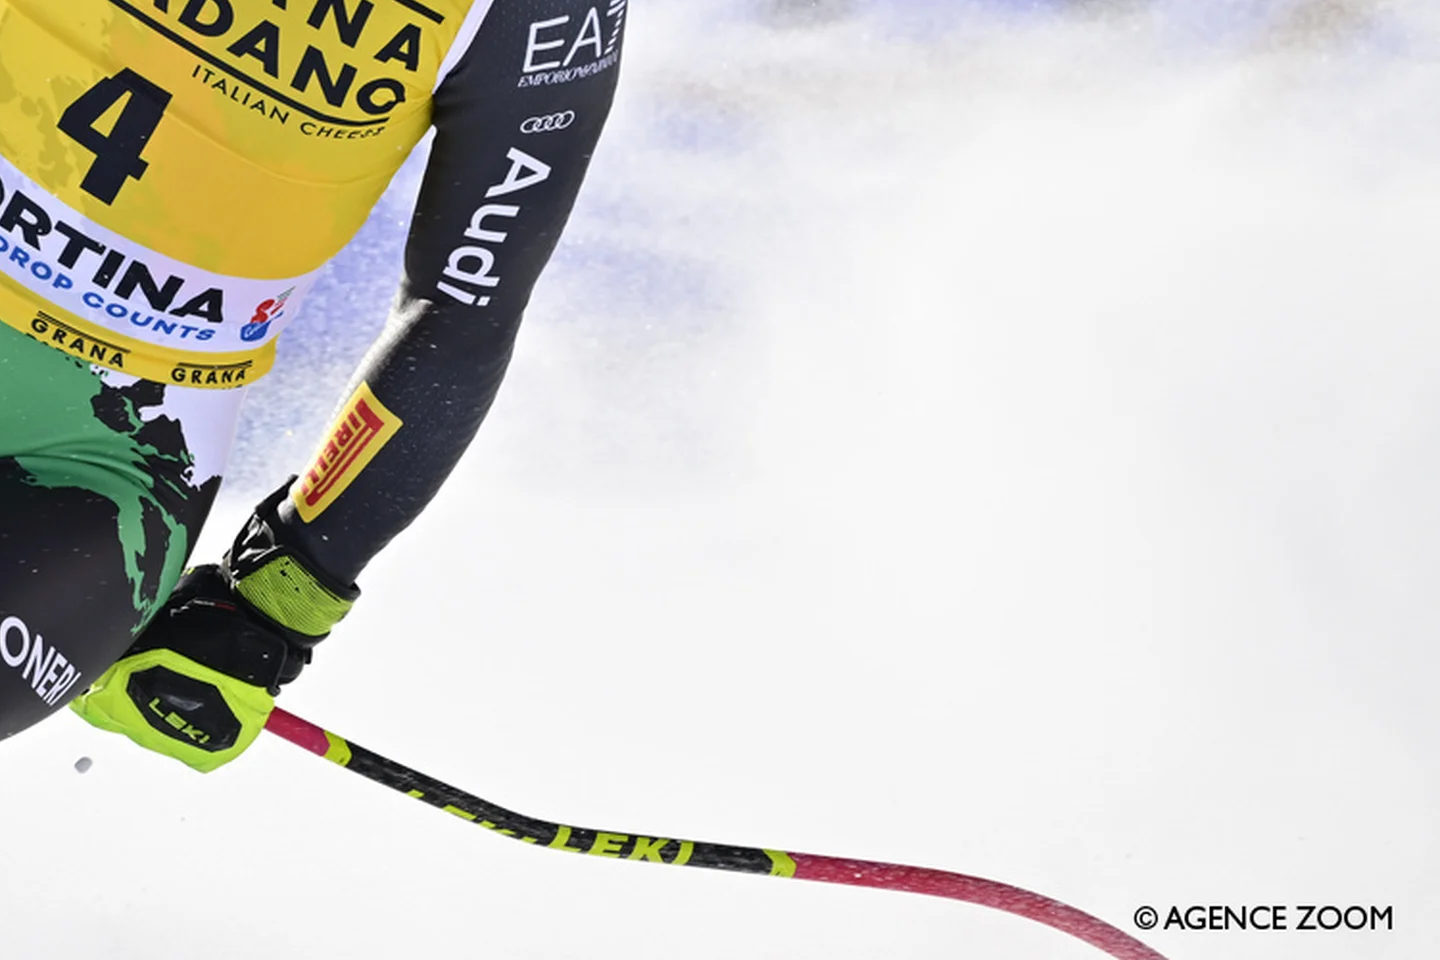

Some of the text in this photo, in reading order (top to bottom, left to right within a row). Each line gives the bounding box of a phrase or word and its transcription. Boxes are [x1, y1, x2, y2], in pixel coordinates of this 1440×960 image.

[191, 63, 290, 125] ITALIAN
[57, 67, 174, 207] 4
[436, 146, 552, 307] Audi
[82, 291, 217, 342] COUNTS
[30, 318, 125, 368] GRANA
[170, 367, 247, 385] GRANA
[148, 697, 211, 745] LEKI
[548, 825, 695, 866] LEKI
